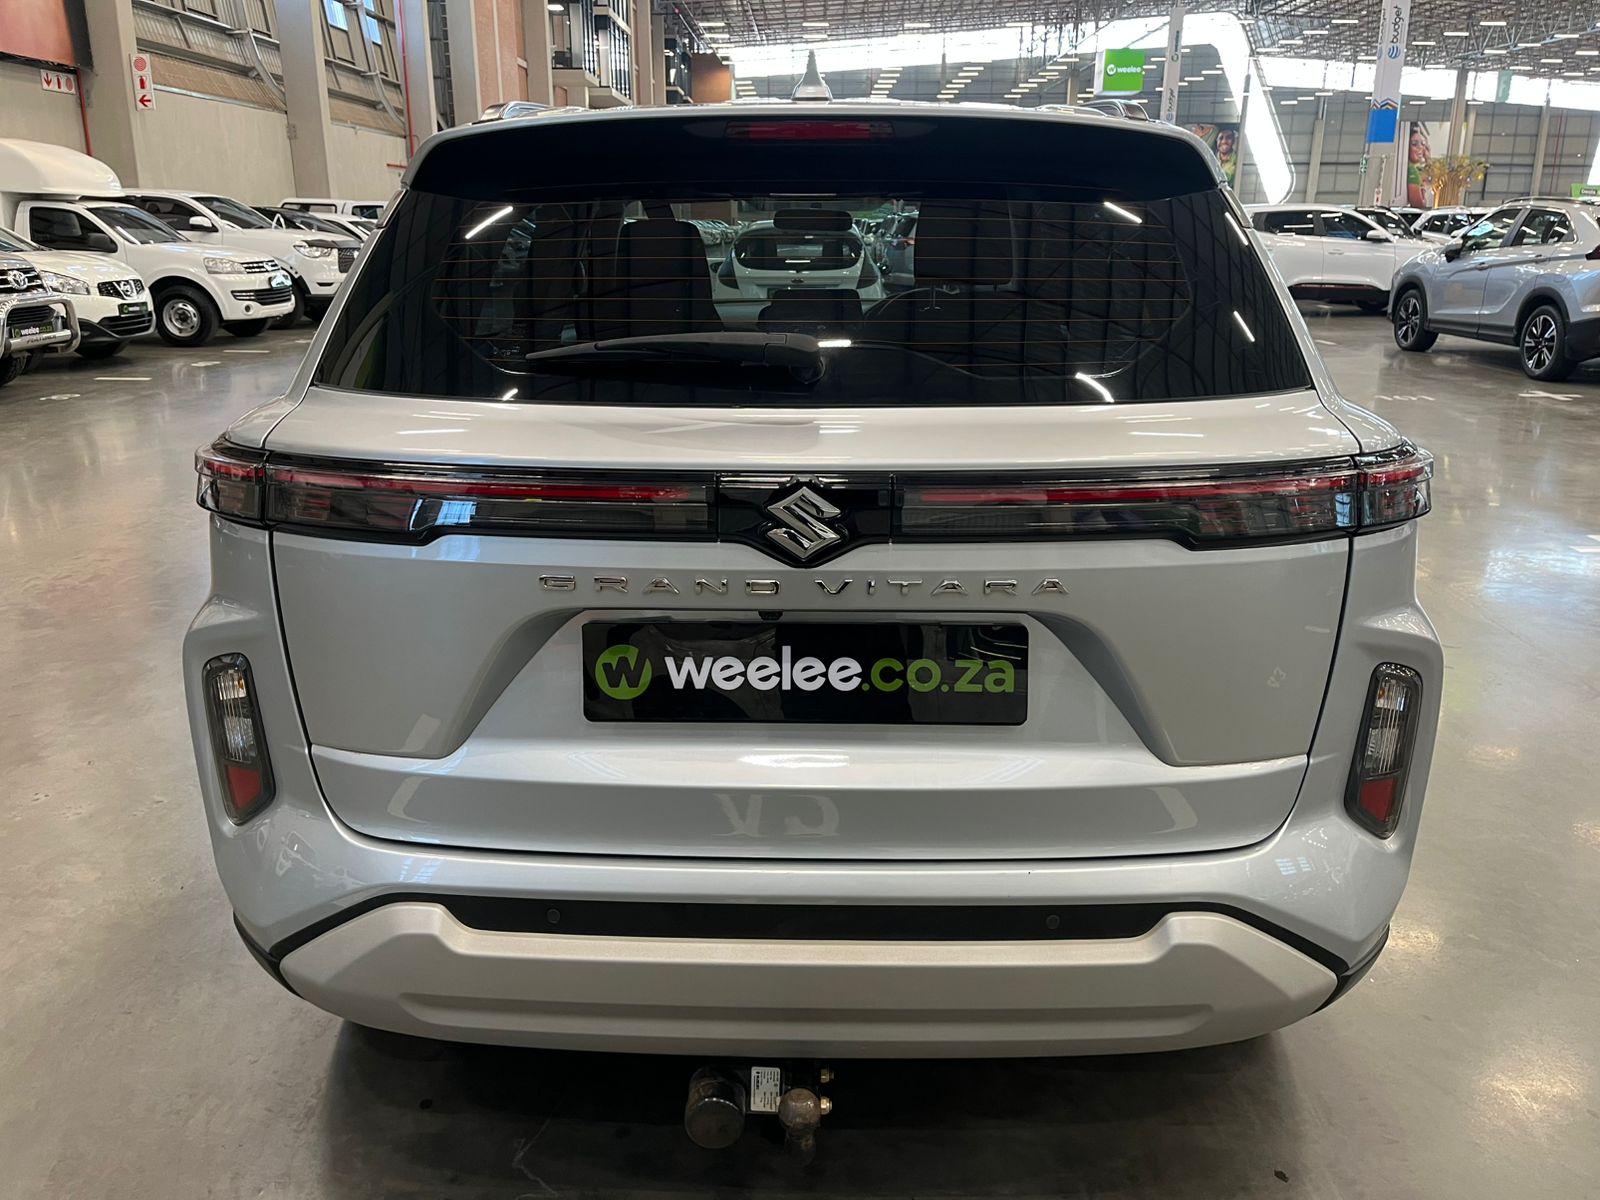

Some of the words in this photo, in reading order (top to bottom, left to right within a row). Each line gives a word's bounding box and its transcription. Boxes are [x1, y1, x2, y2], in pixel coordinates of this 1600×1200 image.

[1390, 5, 1405, 44] budget
[538, 574, 781, 595] GRAND
[814, 578, 1070, 596] VITARA
[664, 645, 1015, 693] weelee.co.za
